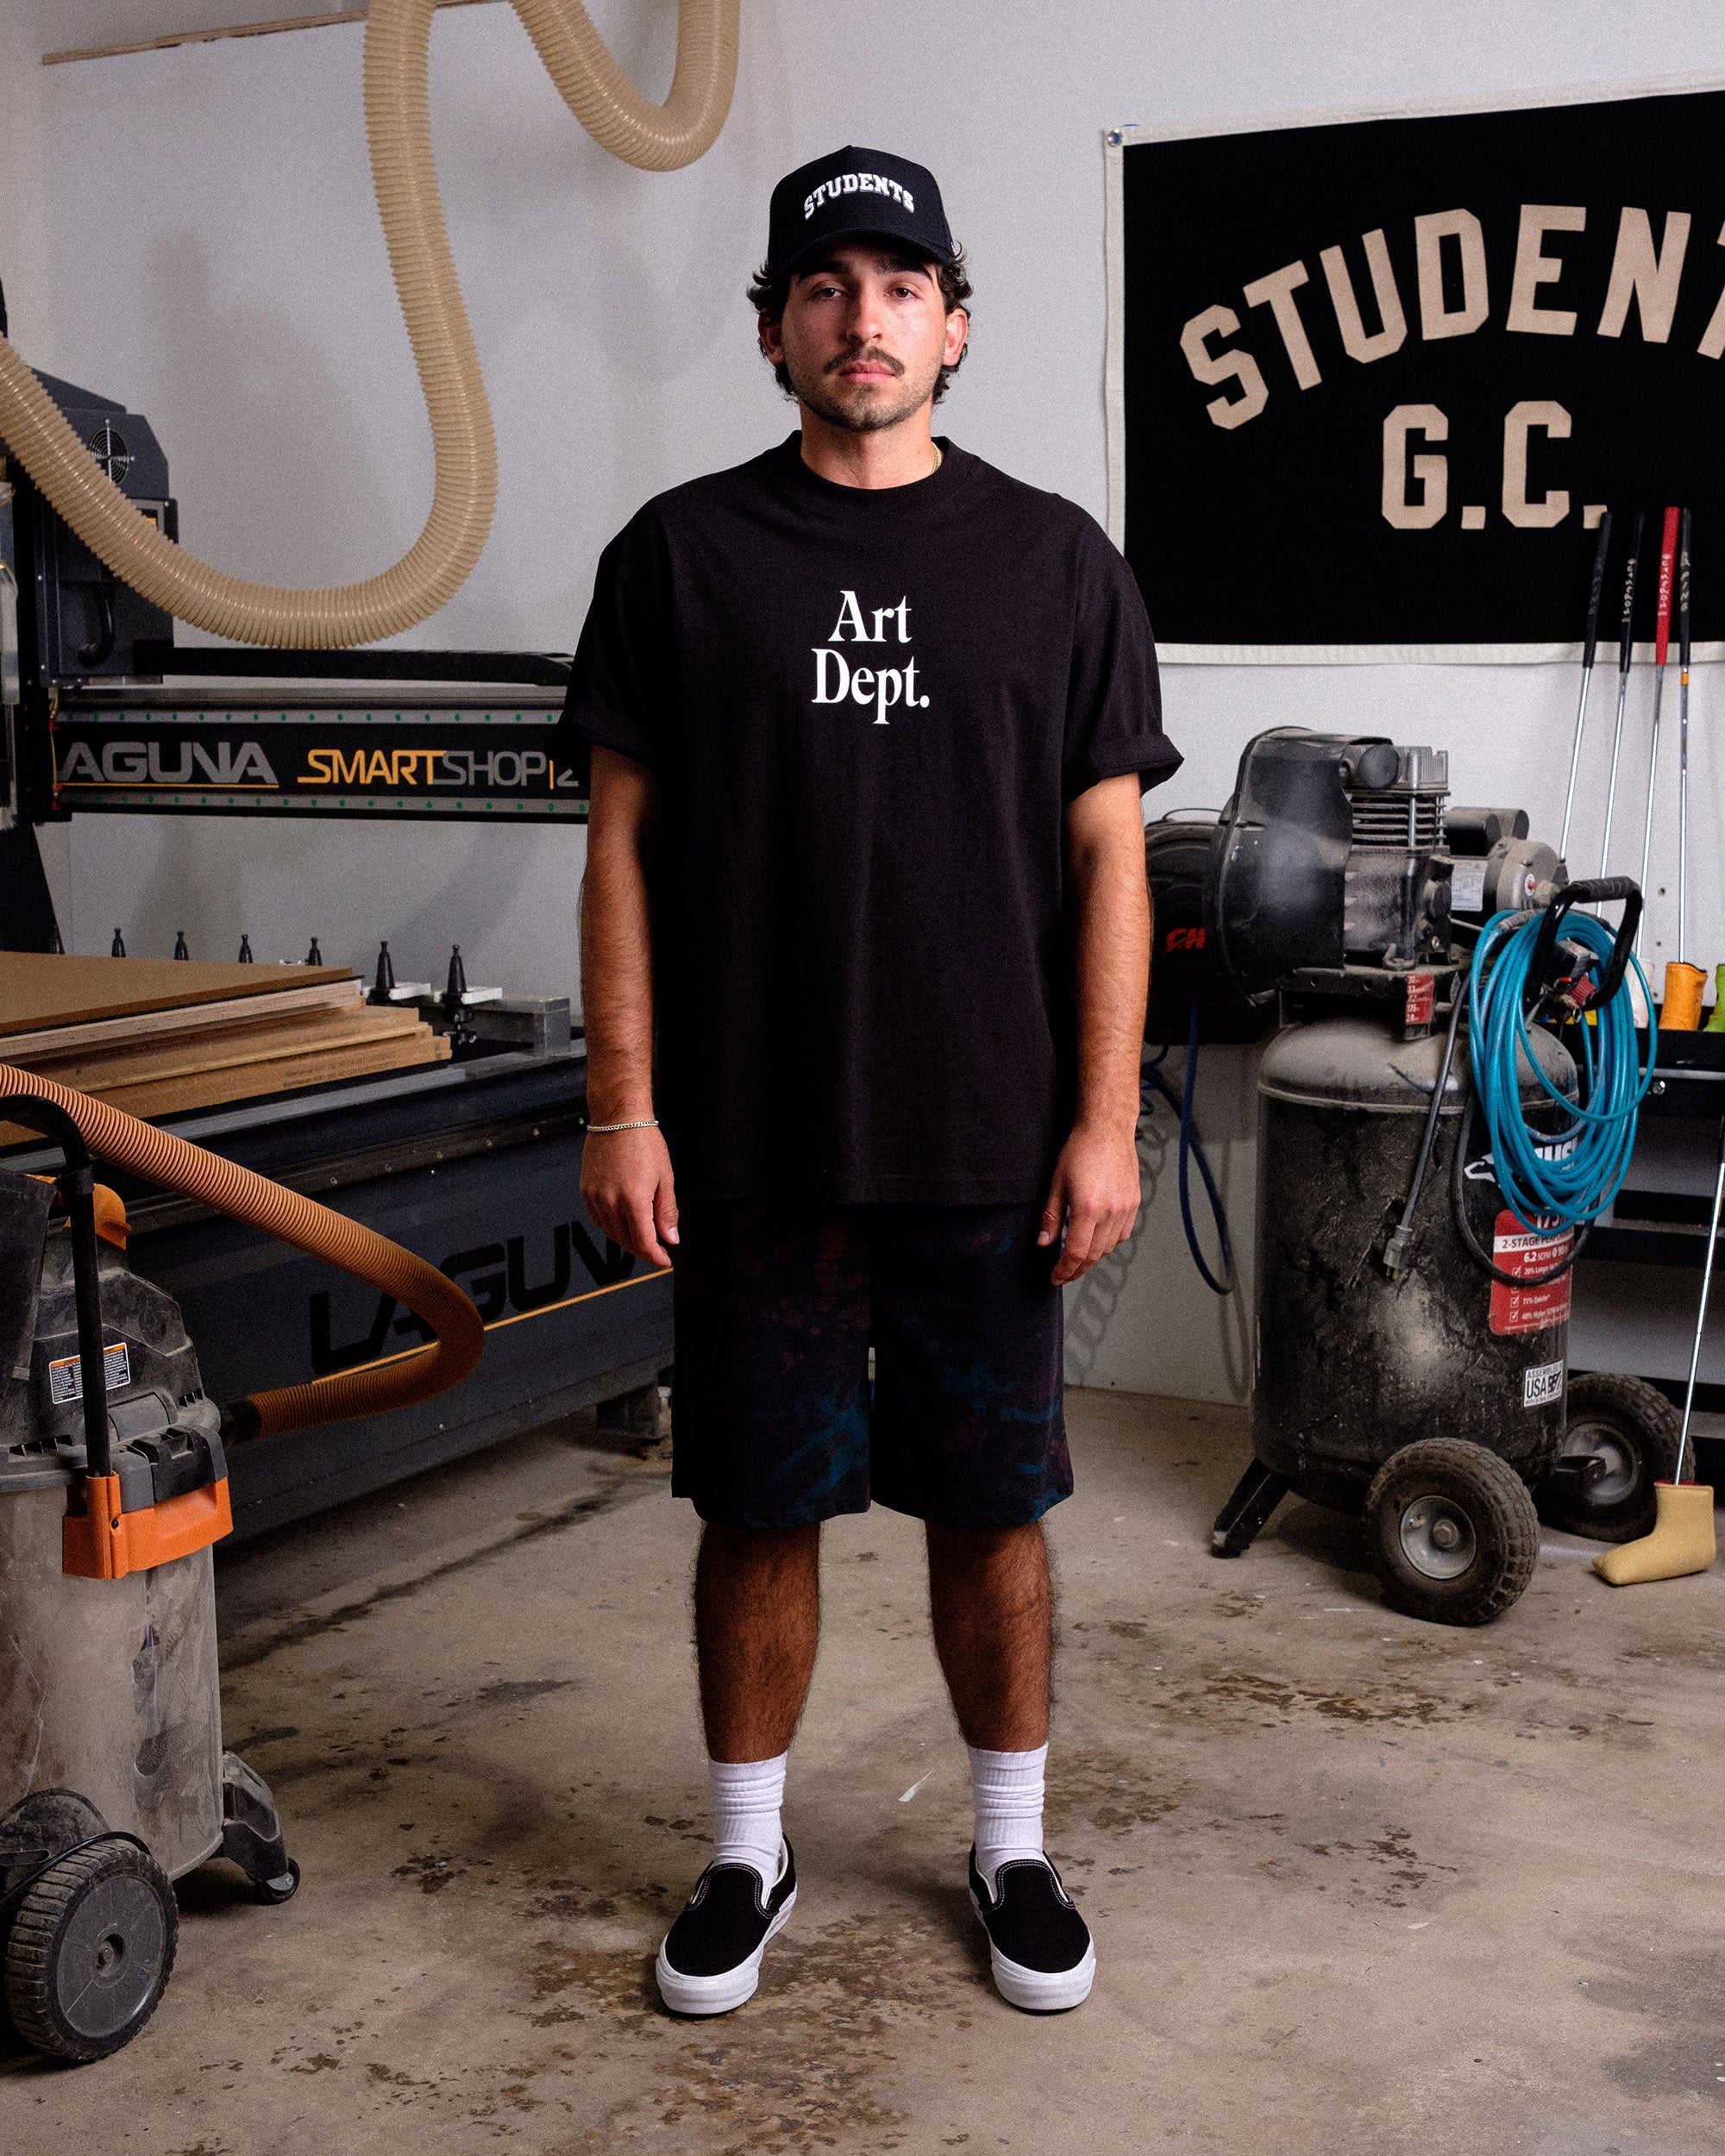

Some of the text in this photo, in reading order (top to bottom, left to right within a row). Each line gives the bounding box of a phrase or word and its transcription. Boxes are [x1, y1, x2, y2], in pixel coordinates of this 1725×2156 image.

[804, 172, 915, 220] STUDENTS
[1382, 400, 1608, 530] G.C.
[827, 590, 913, 643] Art
[812, 649, 930, 724] Dept.
[57, 742, 279, 784] AGUNA
[1165, 928, 1206, 953] CH
[1502, 1236, 1540, 1249] 2-STAGE
[1523, 1251, 1537, 1263] 6.2
[310, 1220, 638, 1376] LAGUN
[1527, 1377, 1546, 1399] USA
